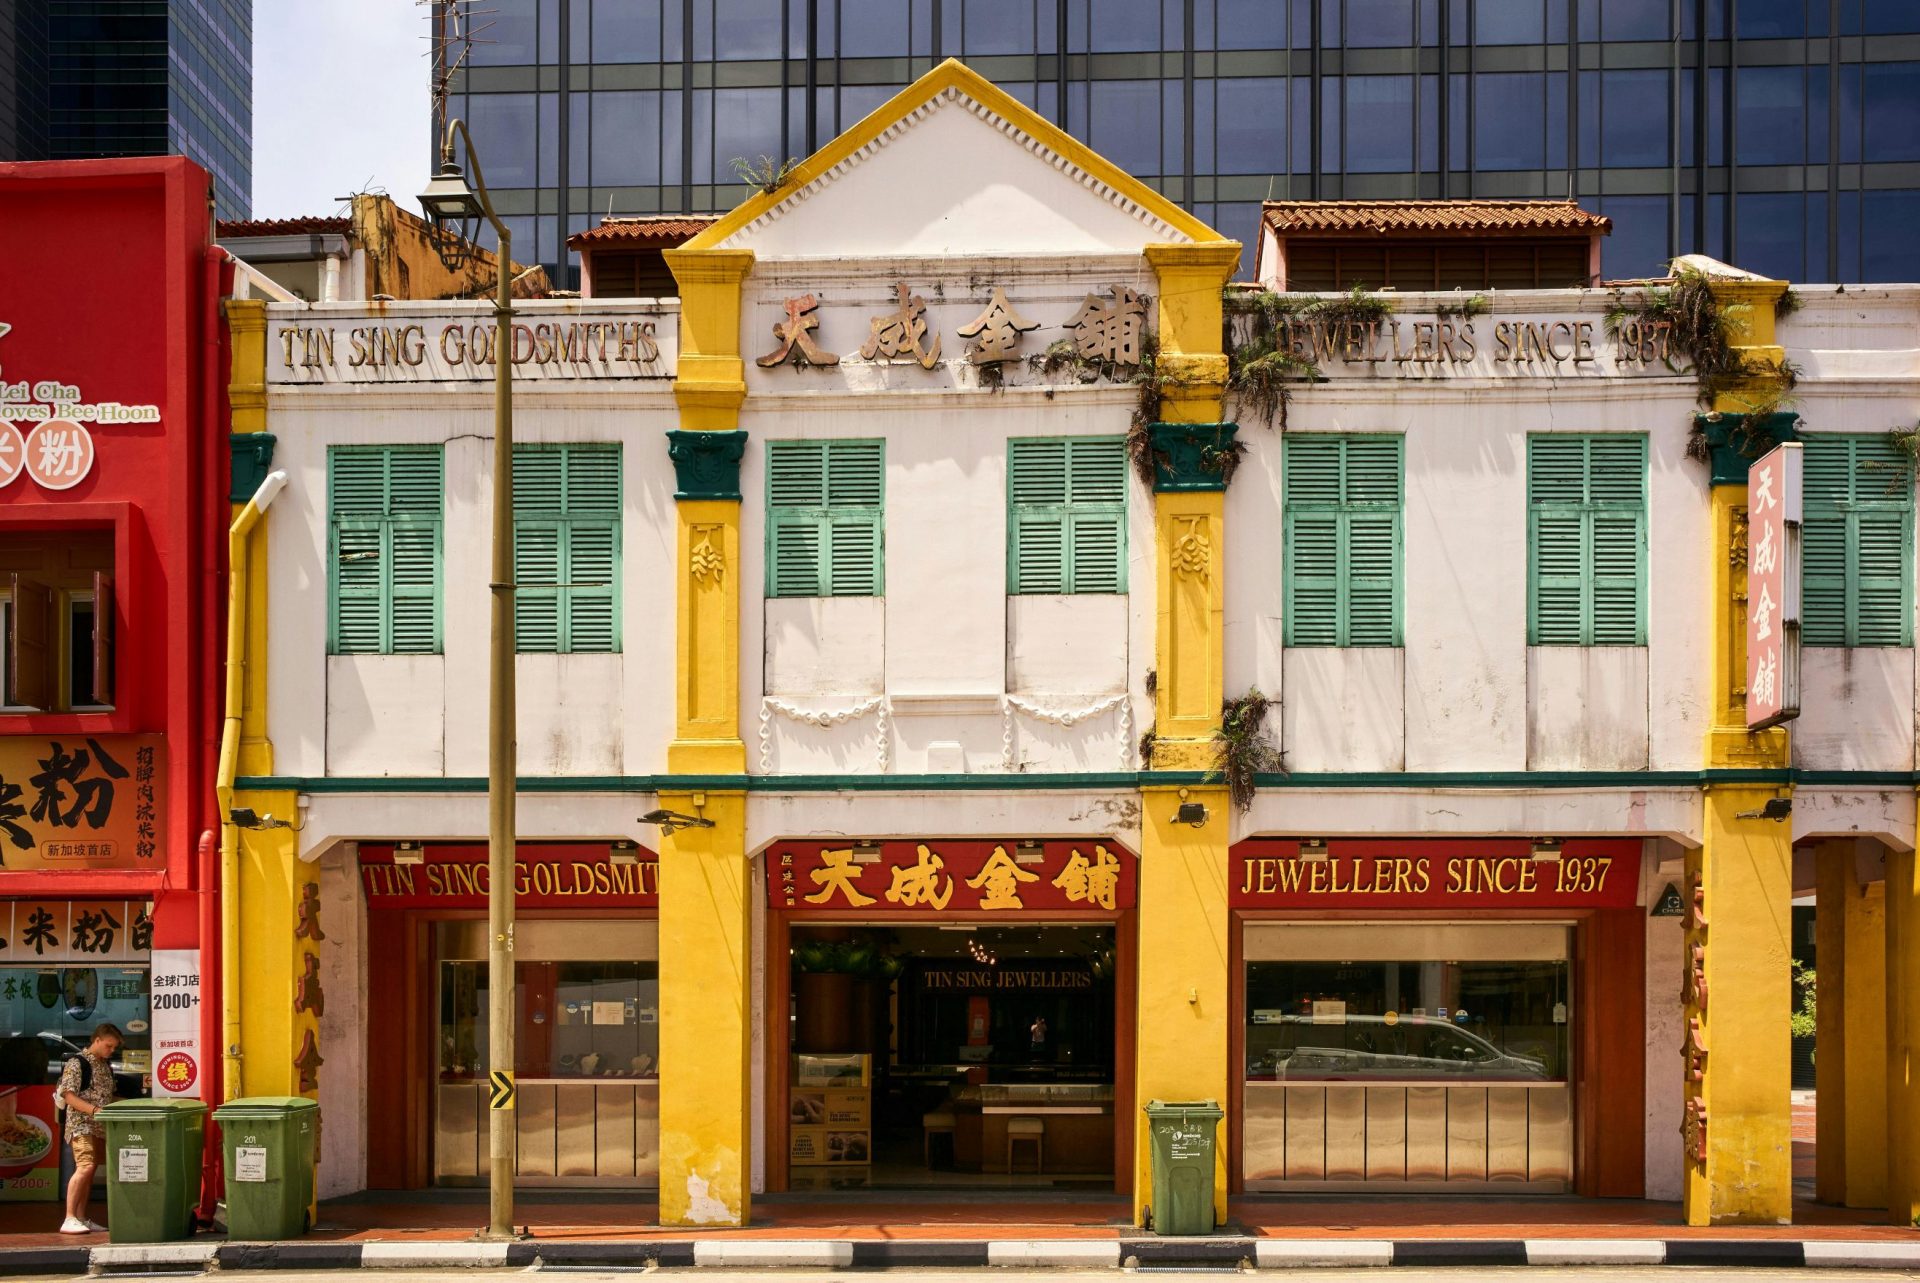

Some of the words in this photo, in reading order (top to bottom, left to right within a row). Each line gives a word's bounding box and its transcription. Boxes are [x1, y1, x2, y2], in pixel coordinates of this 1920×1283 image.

[279, 323, 334, 367] TIN
[349, 323, 424, 367] SING
[1494, 320, 1596, 363] SINCE
[1614, 320, 1673, 363] 1937
[36, 384, 77, 399] Cha
[0, 405, 47, 418] oves
[56, 403, 94, 418] Bee
[101, 405, 158, 421] Hoon
[47, 844, 112, 857] 新加坡首店
[362, 863, 415, 896] TIN
[1241, 858, 1430, 893] JEWELLERS
[1446, 858, 1538, 893] SINCE
[1555, 857, 1612, 893] 1937
[153, 975, 200, 987] 全球门店
[925, 971, 952, 988] TIN
[956, 971, 991, 988] SING
[996, 971, 1091, 988] JEWELLERS
[153, 993, 200, 1010] 2000+
